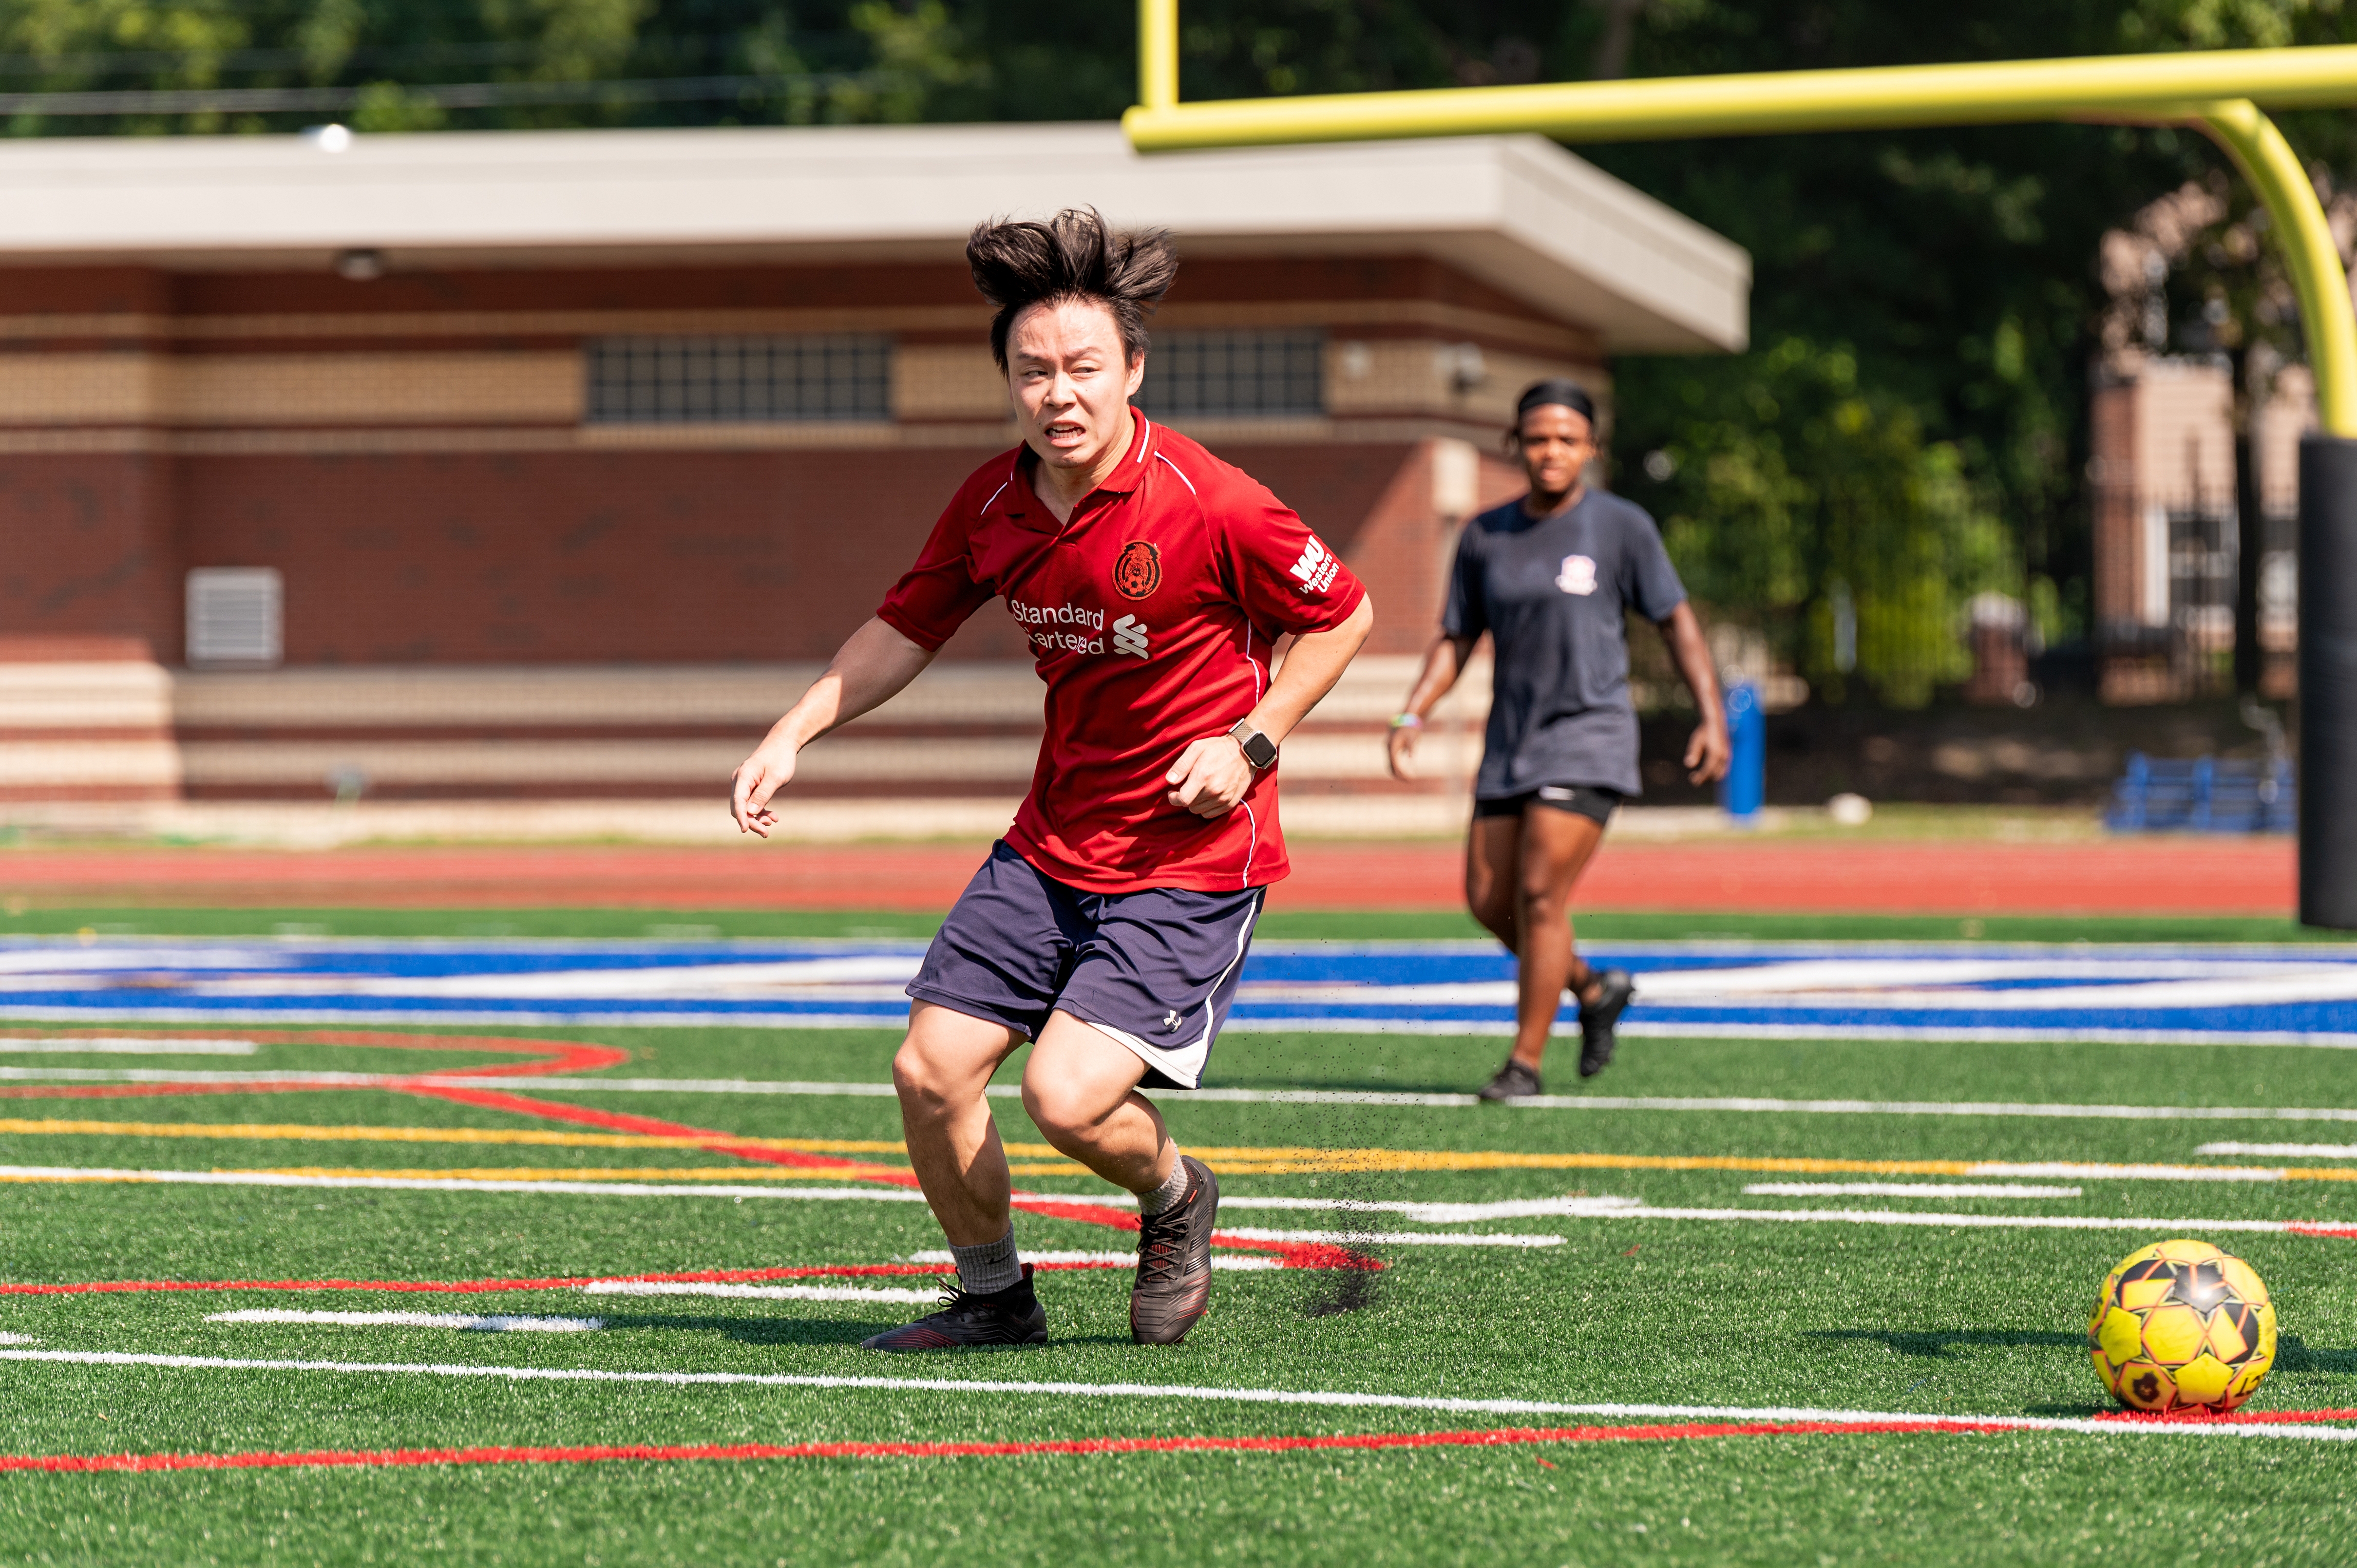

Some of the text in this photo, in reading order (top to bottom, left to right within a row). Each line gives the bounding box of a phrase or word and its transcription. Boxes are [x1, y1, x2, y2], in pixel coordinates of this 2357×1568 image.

[1289, 534, 1325, 582] WU
[1299, 553, 1333, 594] Western
[1317, 562, 1340, 593] Union
[1011, 600, 1104, 631] Standard
[1023, 626, 1105, 654] artered
